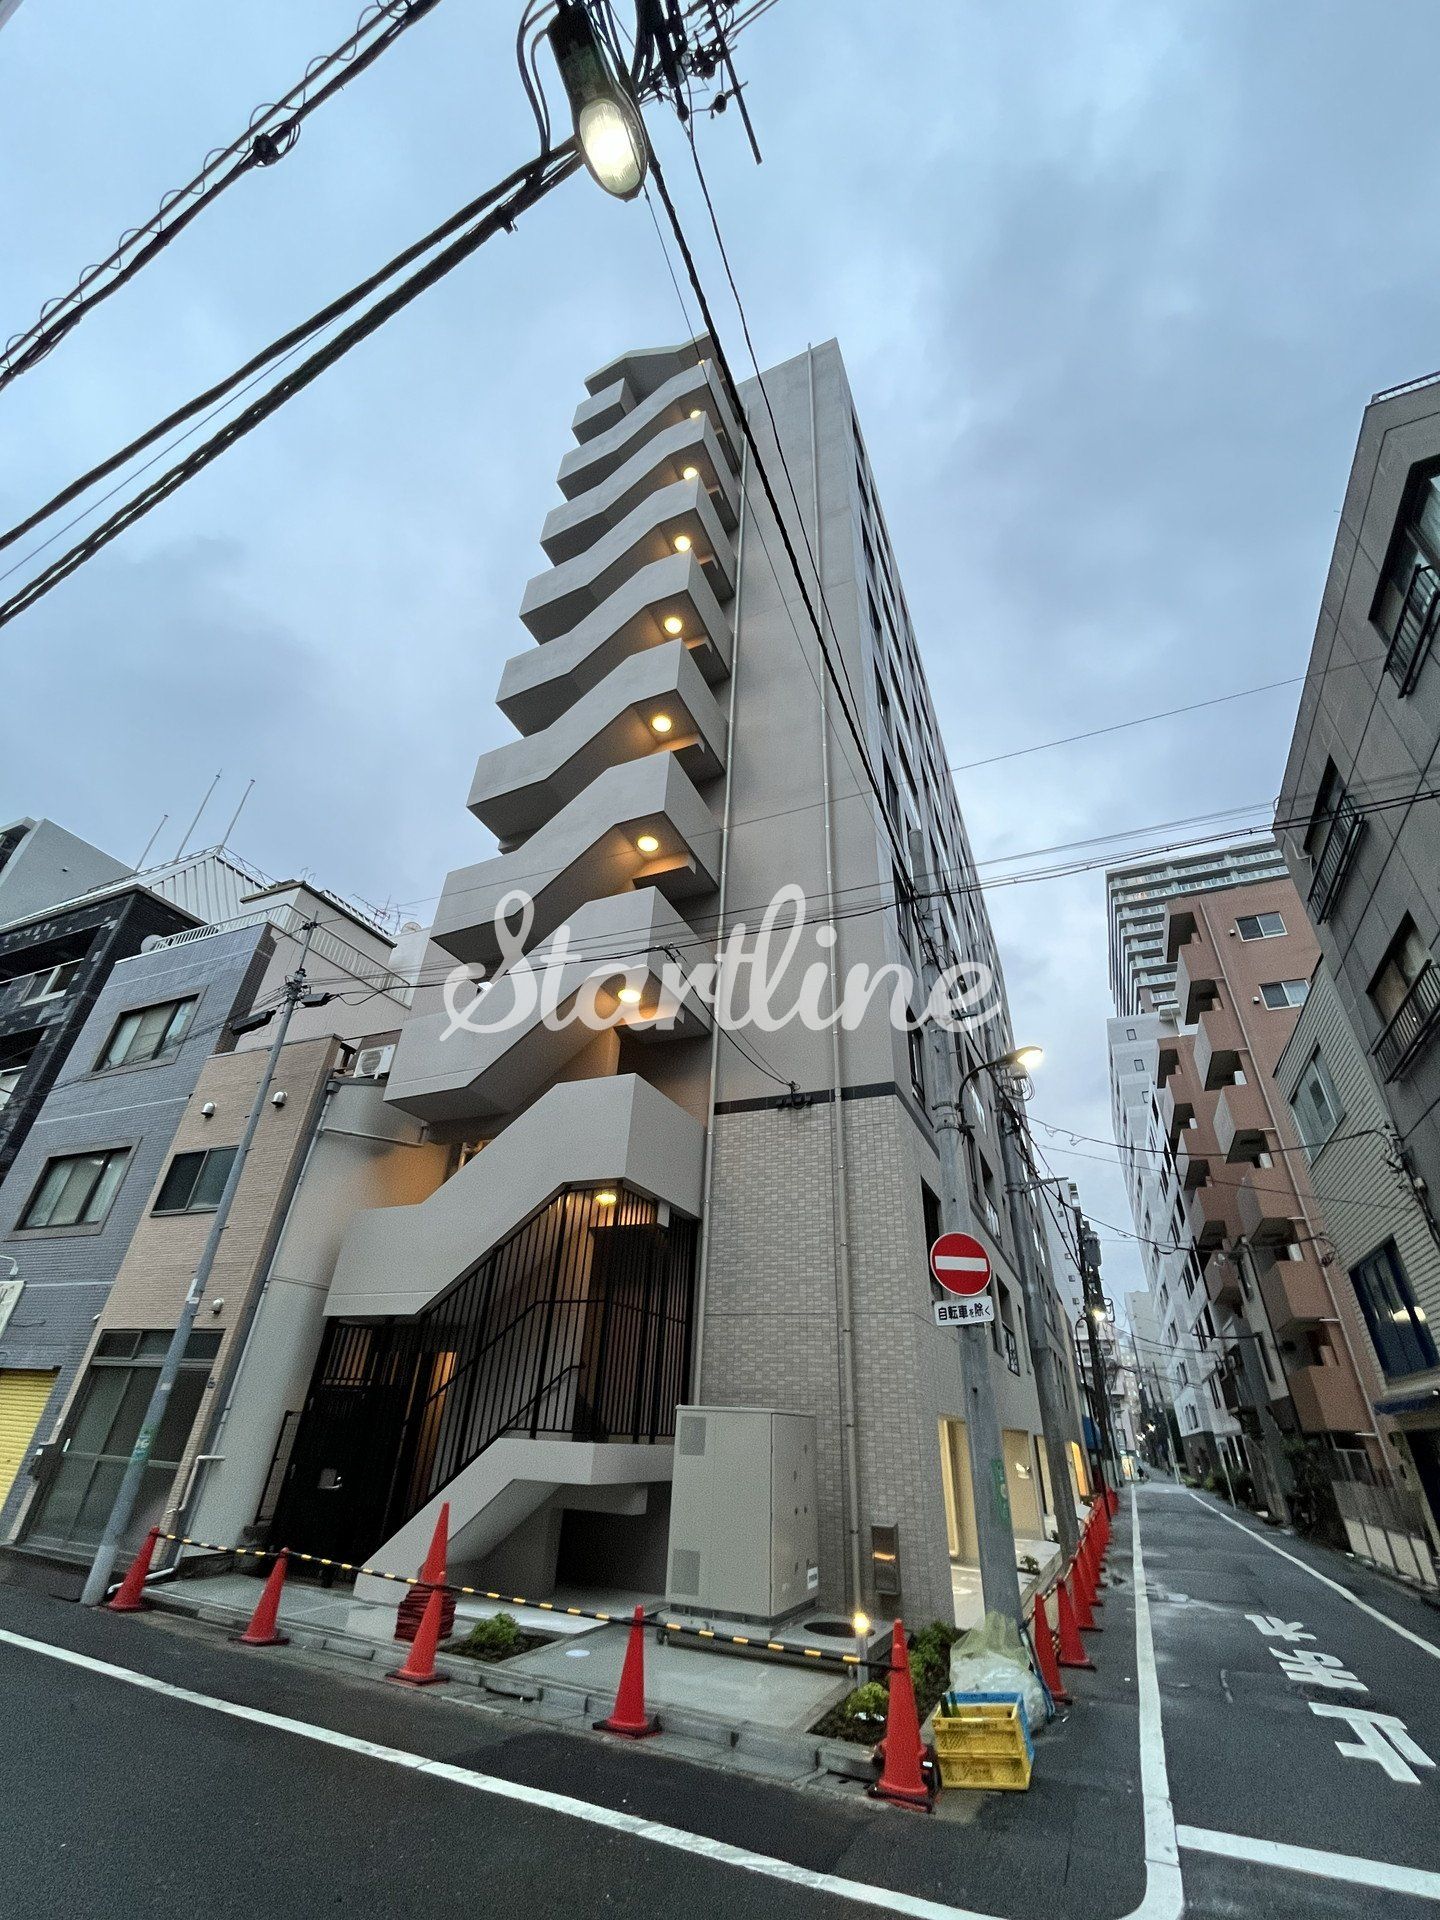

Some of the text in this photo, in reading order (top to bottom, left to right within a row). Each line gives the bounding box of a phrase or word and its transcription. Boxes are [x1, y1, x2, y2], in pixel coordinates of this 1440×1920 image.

[938, 1303, 991, 1321] 自転車を除く
